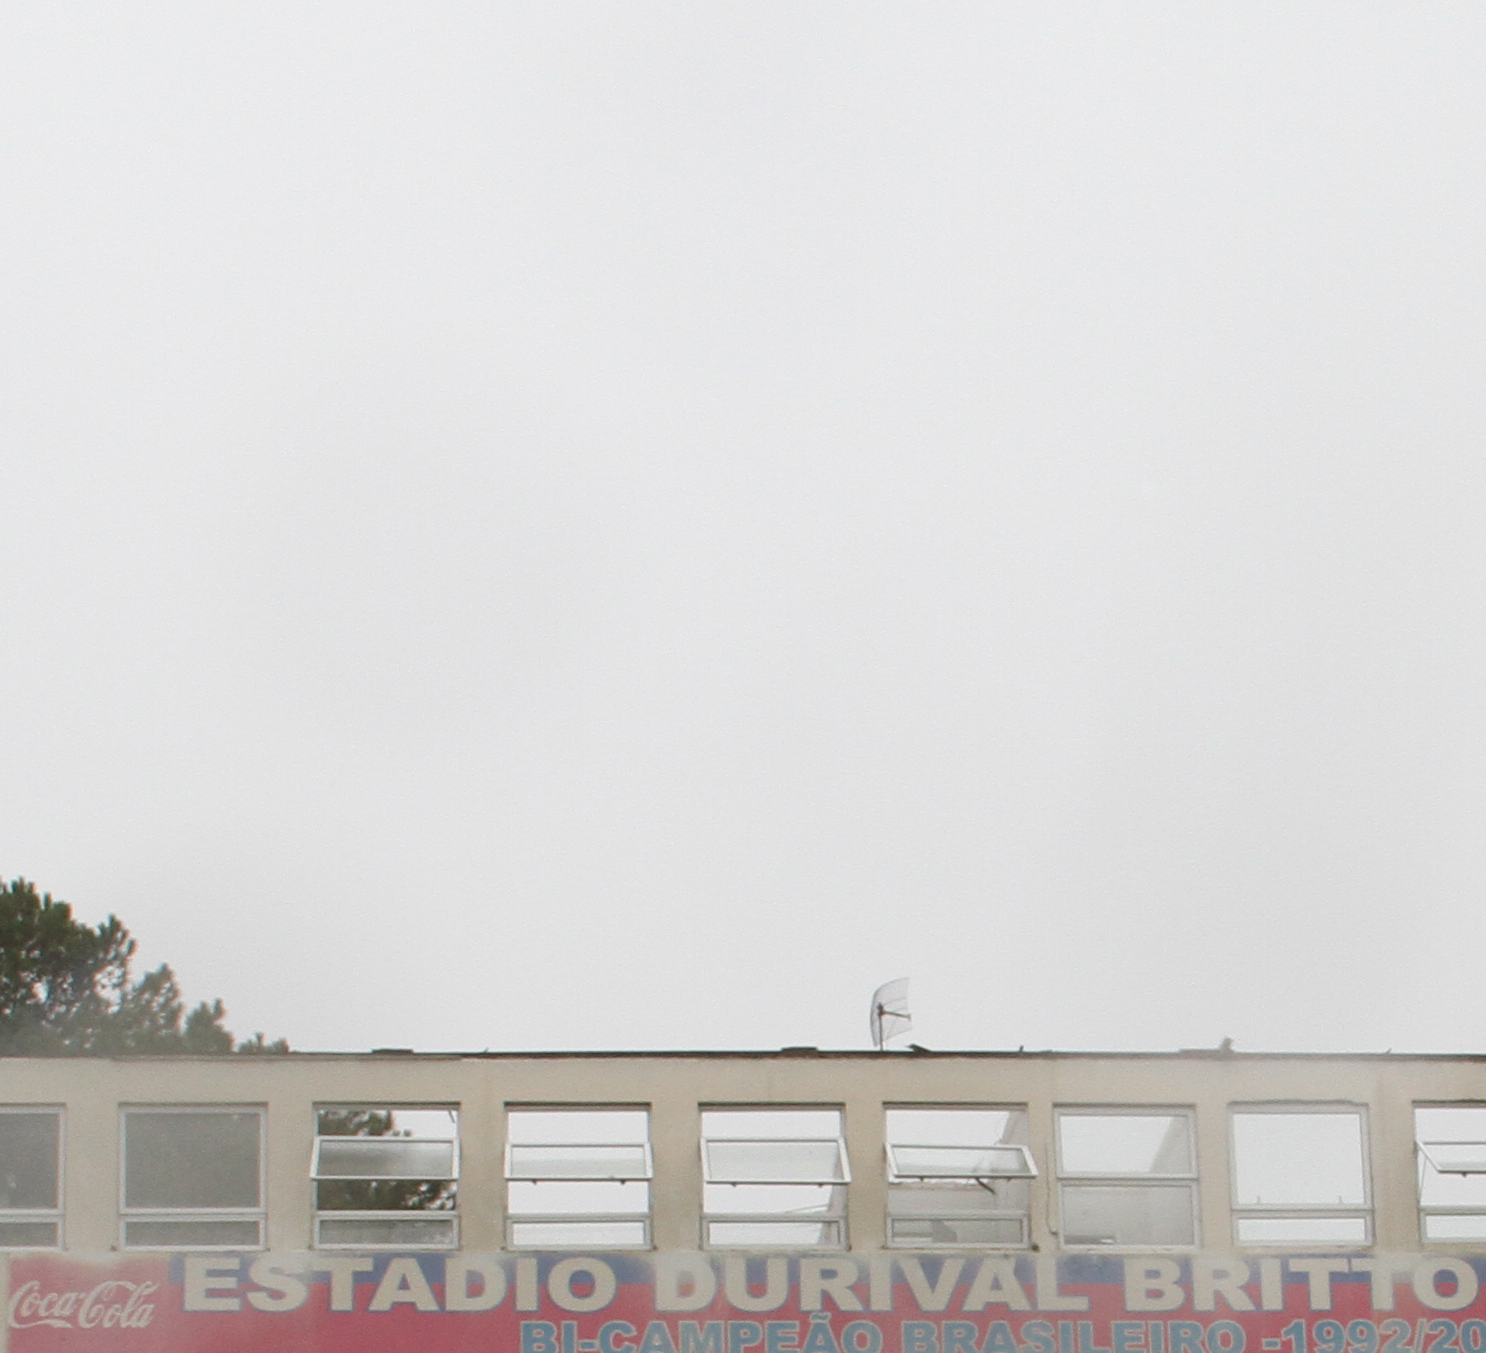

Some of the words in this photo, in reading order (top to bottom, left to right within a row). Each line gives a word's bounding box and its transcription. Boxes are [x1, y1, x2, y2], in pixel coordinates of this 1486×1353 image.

[9, 1280, 160, 1329] Coca-Cola
[182, 1256, 618, 1313] ESTADIO
[654, 1256, 1091, 1312] DURIVAL
[1123, 1256, 1480, 1312] BRITTO
